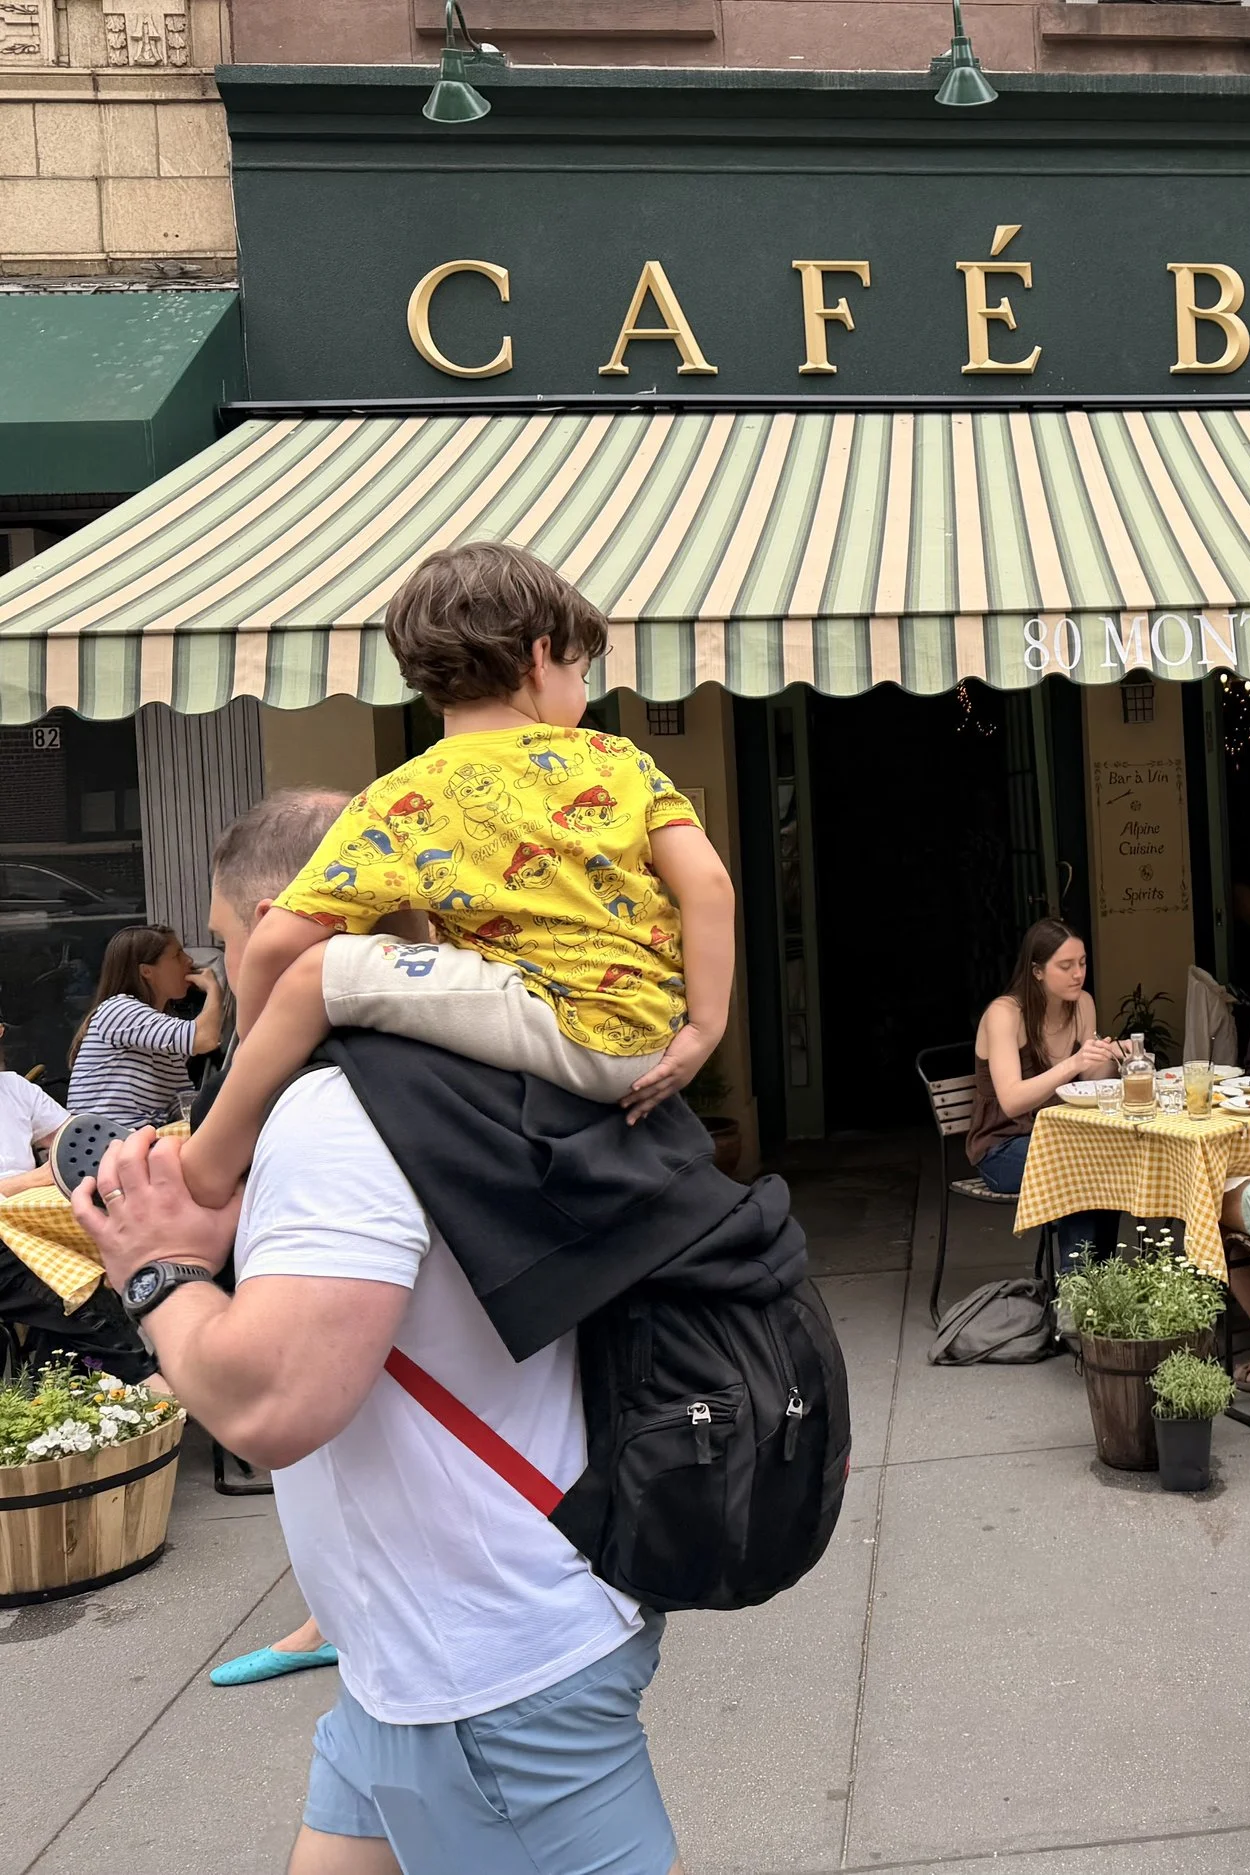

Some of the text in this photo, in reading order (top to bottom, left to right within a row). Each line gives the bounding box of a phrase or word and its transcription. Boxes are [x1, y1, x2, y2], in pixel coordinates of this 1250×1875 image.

[407, 224, 1042, 379] CAFÉ
[1022, 617, 1083, 672] 80
[34, 729, 59, 747] 82
[1109, 769, 1169, 785] Bar à Vin
[1120, 821, 1160, 840] Alpine
[471, 819, 544, 866] PAW PATROL
[1119, 841, 1165, 856] Cuisine
[1122, 886, 1164, 905] Spirits
[563, 962, 591, 982] PAW
